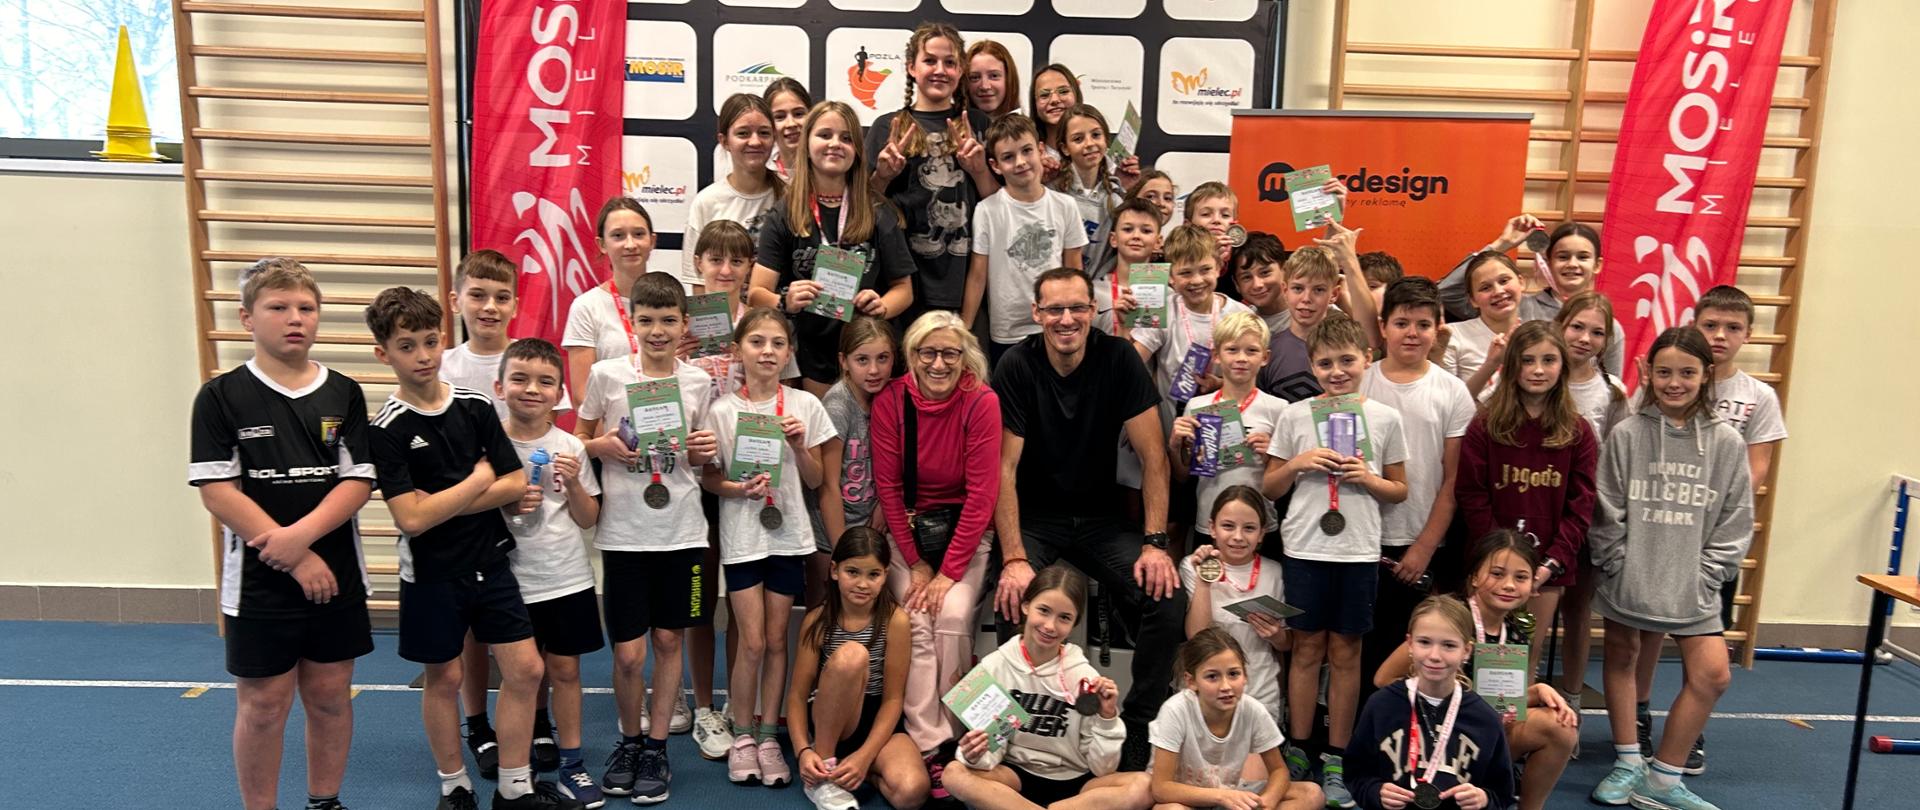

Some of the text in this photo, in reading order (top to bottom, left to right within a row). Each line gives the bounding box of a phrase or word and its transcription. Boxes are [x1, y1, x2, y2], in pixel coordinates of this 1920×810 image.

[526, 0, 579, 167] MOS
[1197, 86, 1243, 99] mielec.pl
[641, 184, 687, 197] mielec.pl
[1178, 355, 1197, 394] Milka
[1202, 423, 1219, 460] Milka
[1494, 463, 1563, 494] Jagoda
